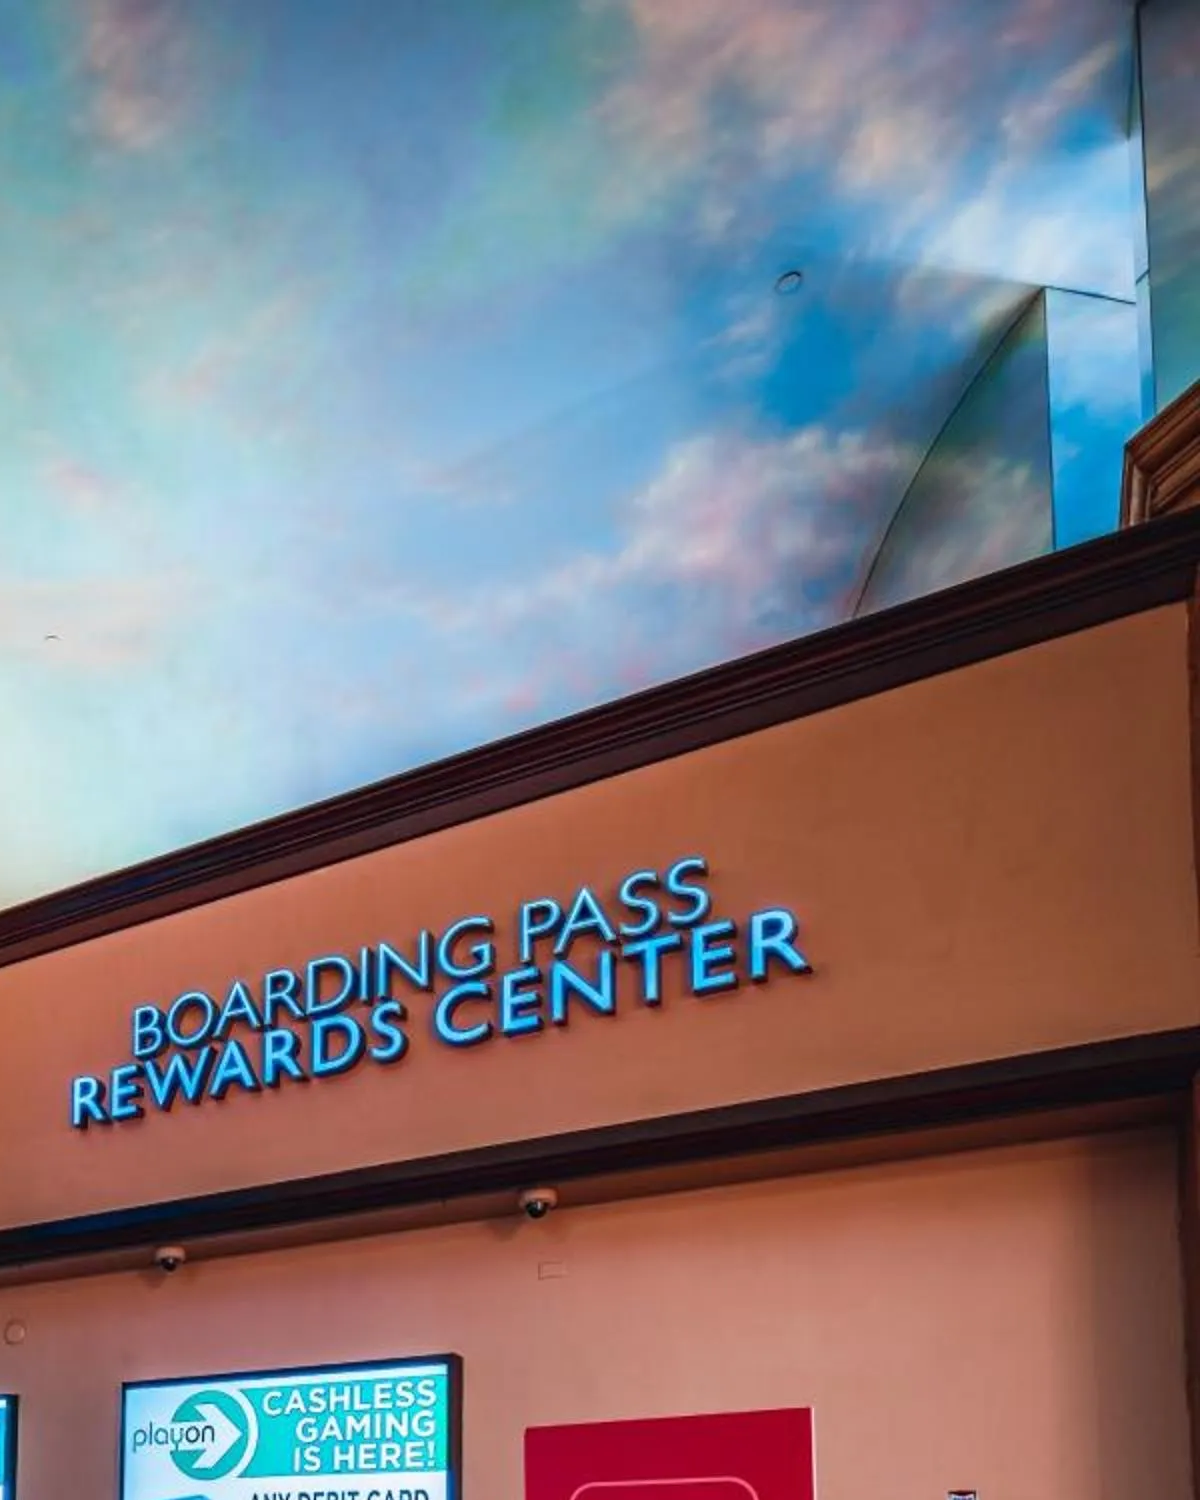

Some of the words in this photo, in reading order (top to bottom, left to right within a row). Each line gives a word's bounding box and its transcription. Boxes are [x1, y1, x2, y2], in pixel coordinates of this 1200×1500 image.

[132, 916, 494, 1060] BOARDING
[519, 857, 712, 963] PASS
[70, 1000, 408, 1130] REWARDS
[435, 907, 814, 1046] CENTER
[262, 1379, 438, 1417] CASHLESS
[132, 1420, 216, 1453] playon
[295, 1409, 436, 1444] GAMING
[293, 1444, 322, 1473] IS
[333, 1440, 436, 1471] HERE!
